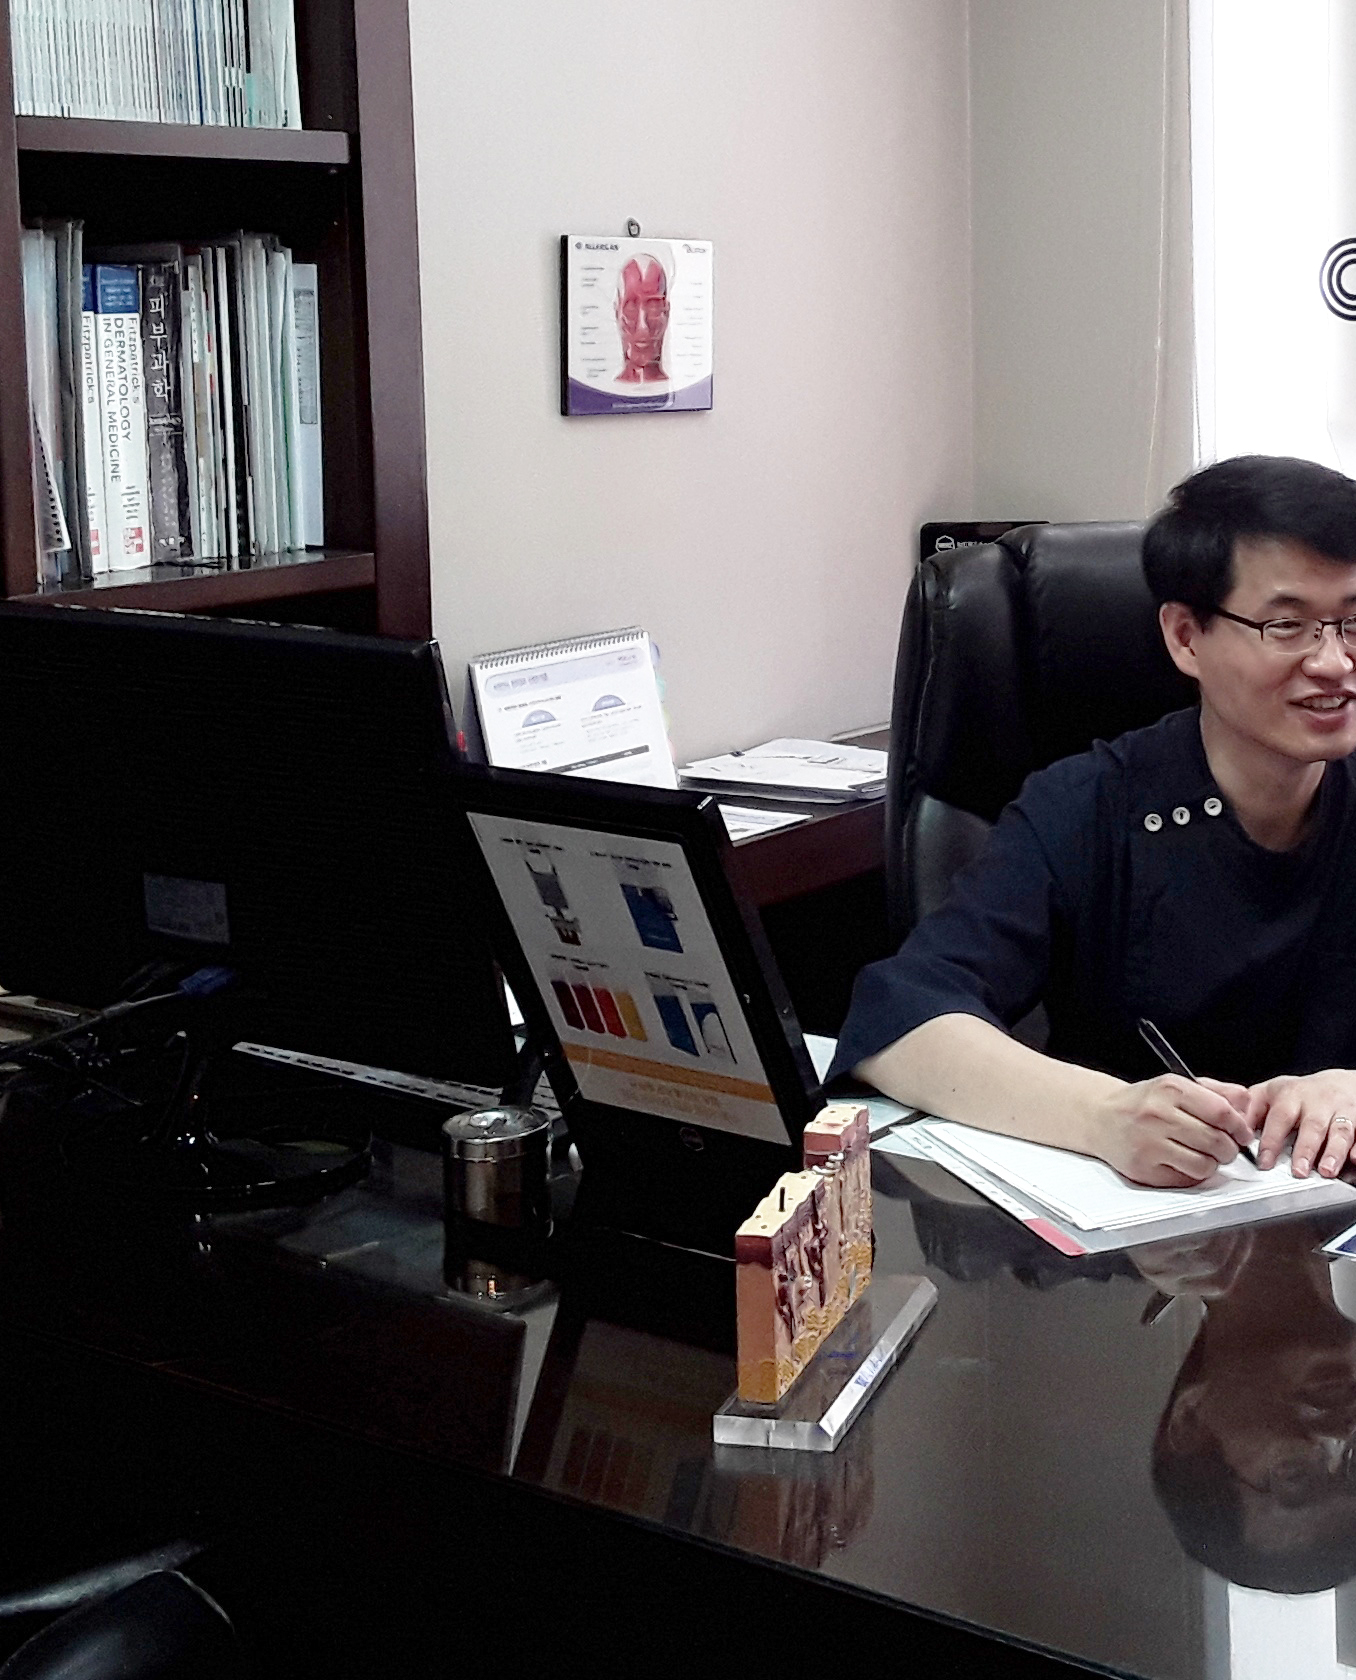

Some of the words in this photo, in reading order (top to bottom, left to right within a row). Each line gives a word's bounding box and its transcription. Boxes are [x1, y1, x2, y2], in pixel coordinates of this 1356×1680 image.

[102, 317, 113, 333] IN
[104, 338, 116, 406] GENERAL
[114, 317, 132, 442] DERMATOLOGY
[106, 411, 122, 484] MEDICINE
